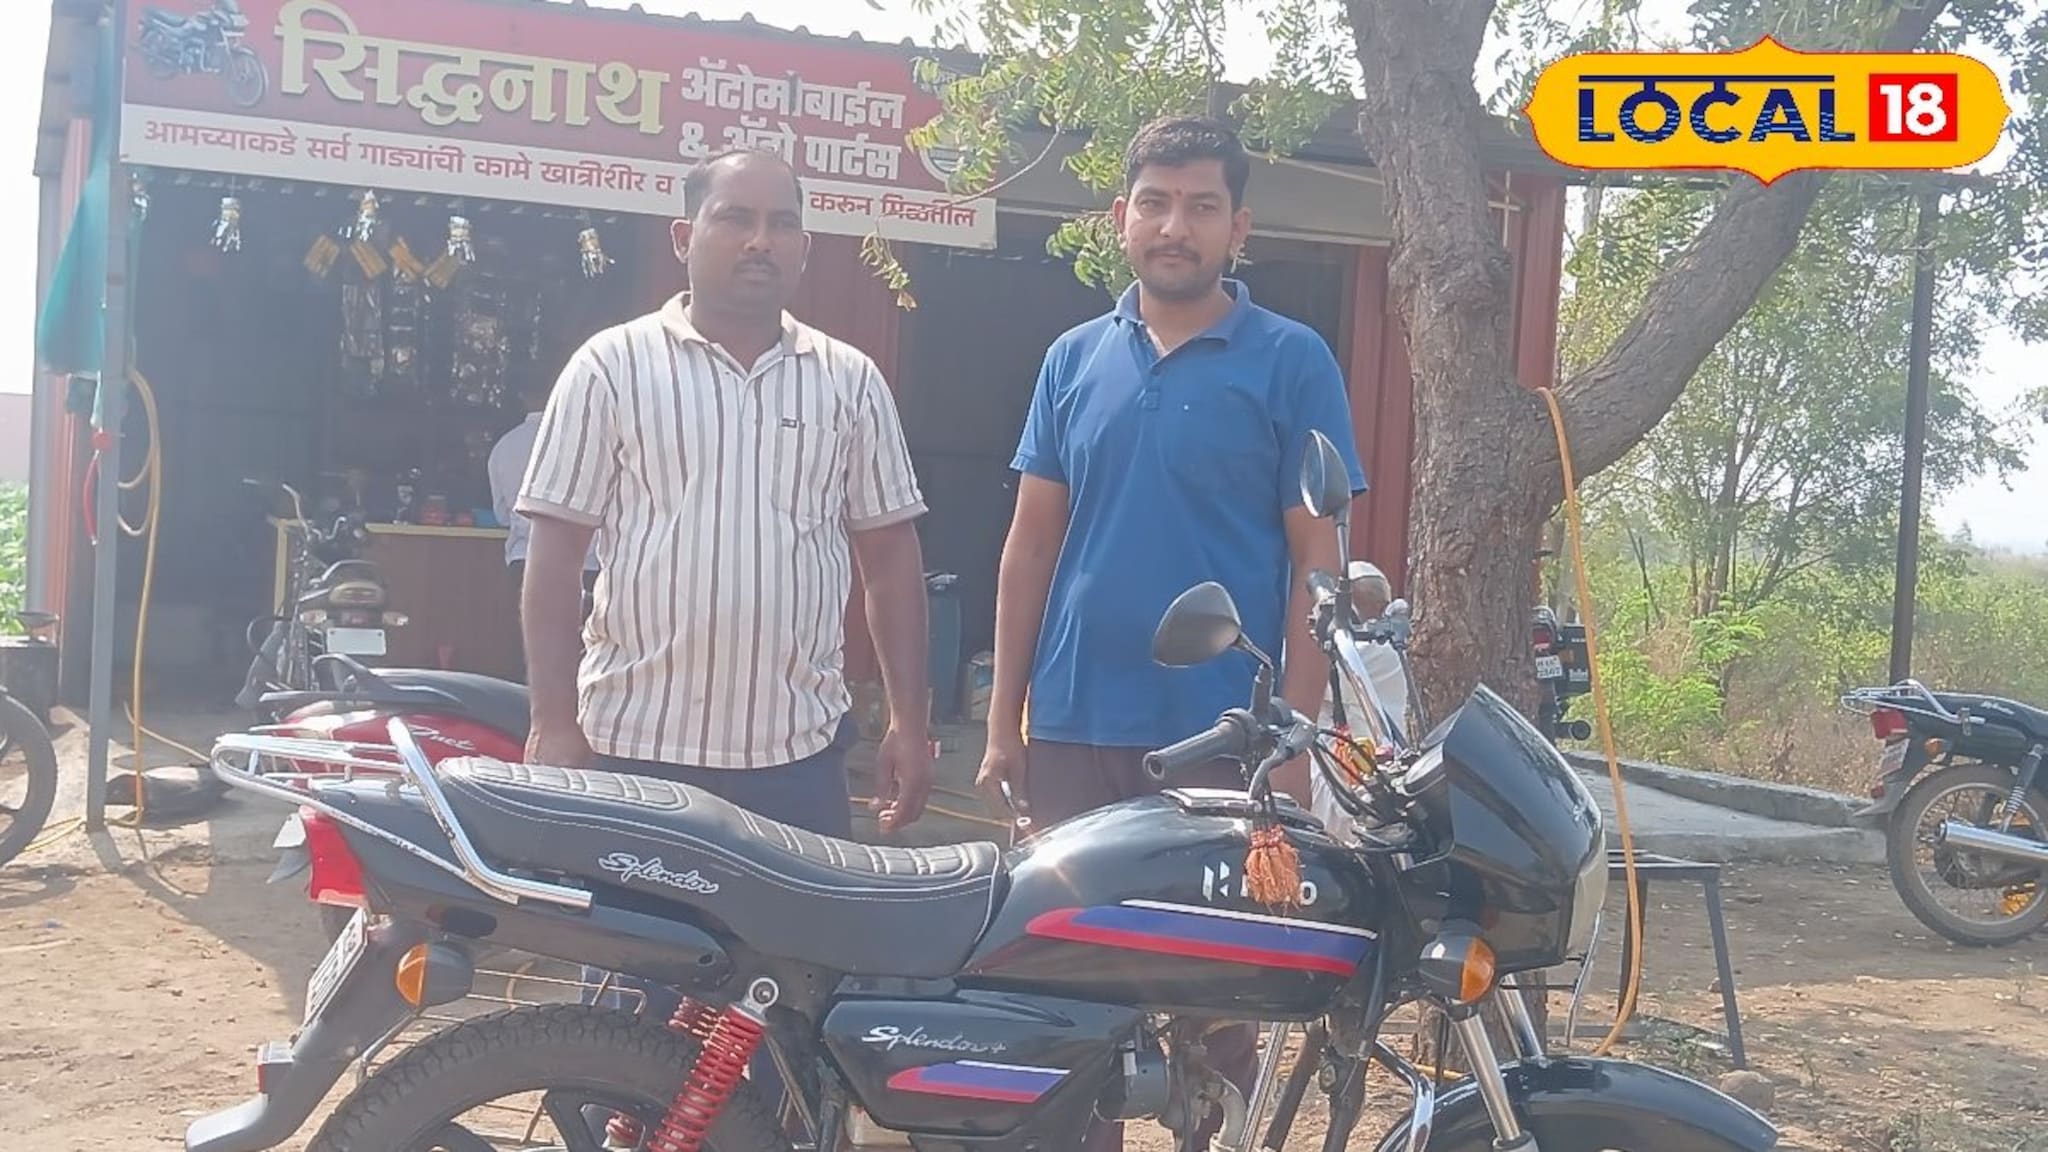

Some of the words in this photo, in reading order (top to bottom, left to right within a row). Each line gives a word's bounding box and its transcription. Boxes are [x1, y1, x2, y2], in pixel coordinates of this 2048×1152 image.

[273, 0, 671, 135] सिद्धनाथ
[144, 119, 298, 156] आमच्याकडे
[306, 132, 352, 161] सर्व
[358, 142, 465, 174] गाड्यांची
[473, 151, 532, 181] कामे
[541, 160, 647, 192] खात्रीशीर
[655, 174, 675, 195] व
[808, 190, 874, 216] करून
[678, 121, 709, 158] &
[803, 132, 902, 180] पार्टस
[598, 852, 720, 894] Splendor
